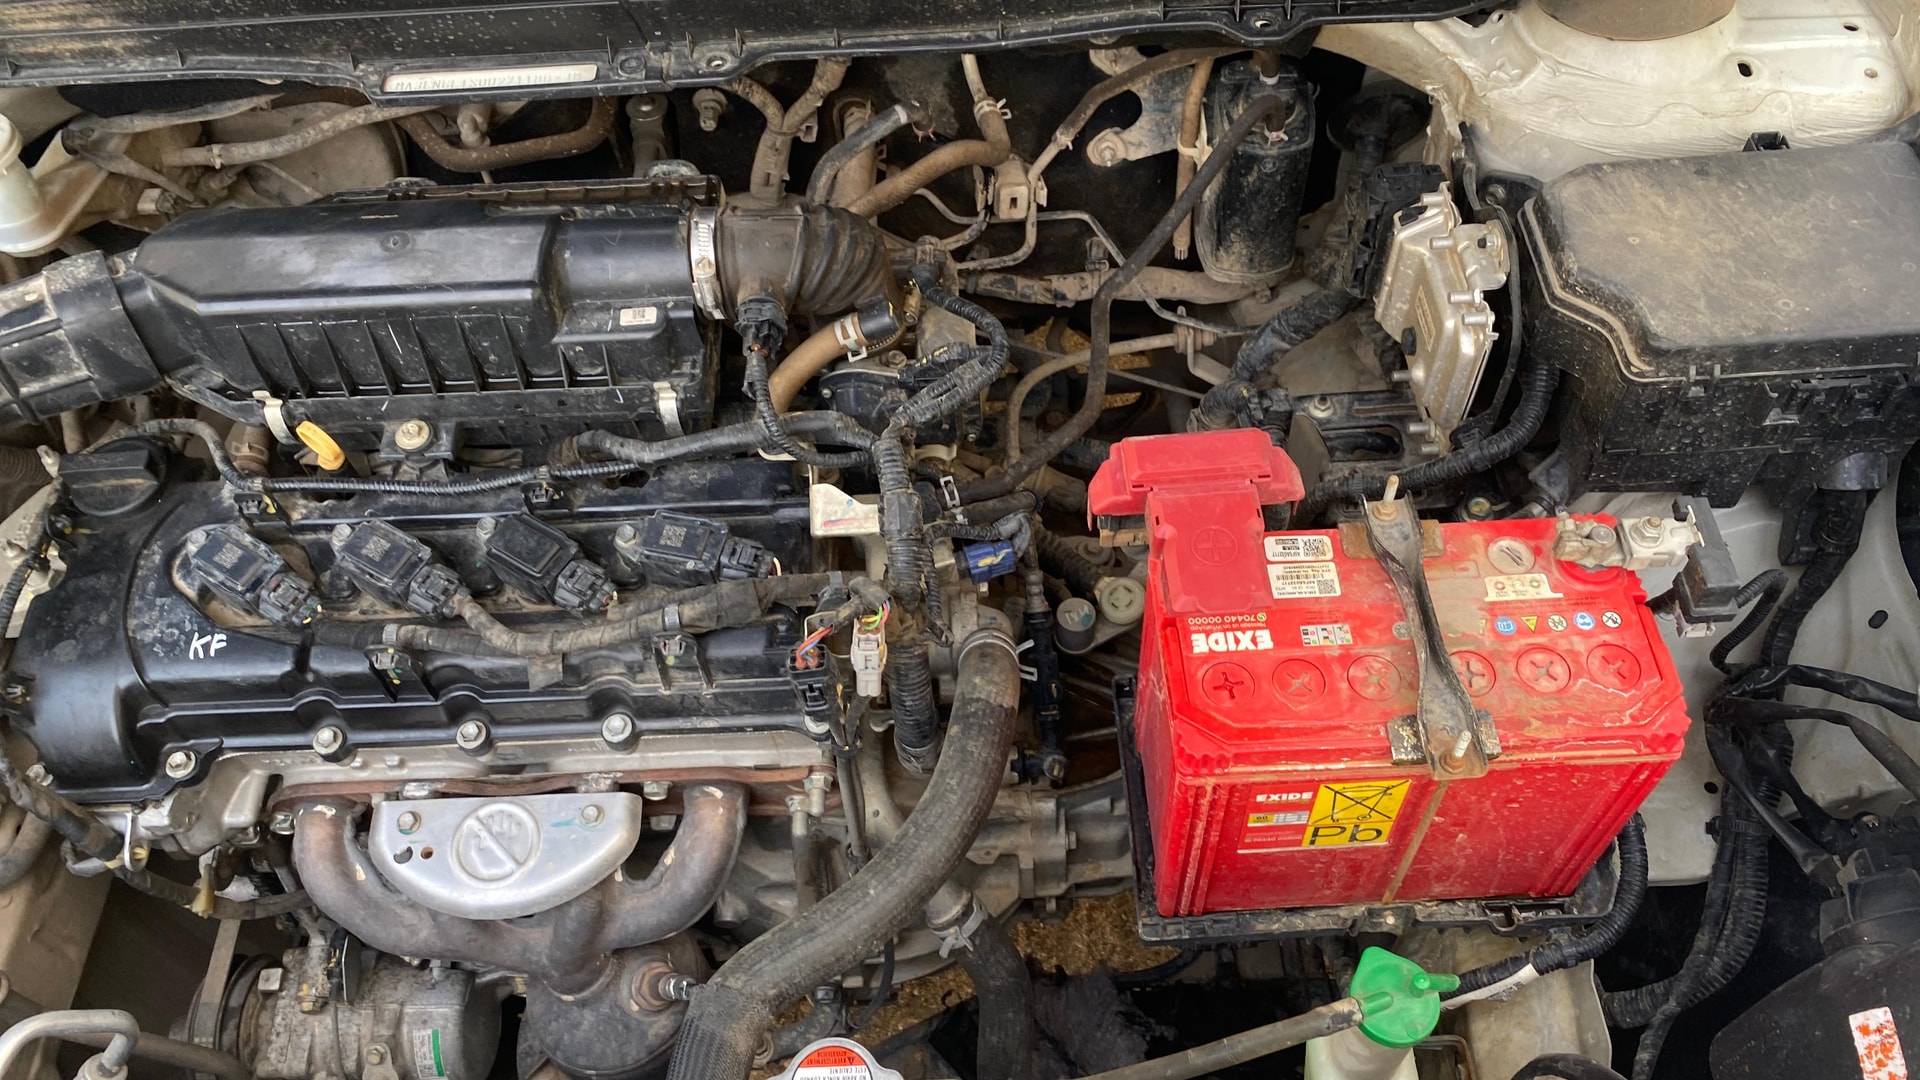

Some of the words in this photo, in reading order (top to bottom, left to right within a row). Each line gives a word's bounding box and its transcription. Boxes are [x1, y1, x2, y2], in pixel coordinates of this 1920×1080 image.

[1188, 616, 1222, 625] 00000
[1224, 614, 1256, 622] 70440
[1190, 624, 1222, 632] WhatsApp
[189, 631, 227, 660] KF
[1191, 629, 1274, 654] EXIDE
[1255, 791, 1314, 802] EXIDE
[1309, 824, 1383, 846] Pb
